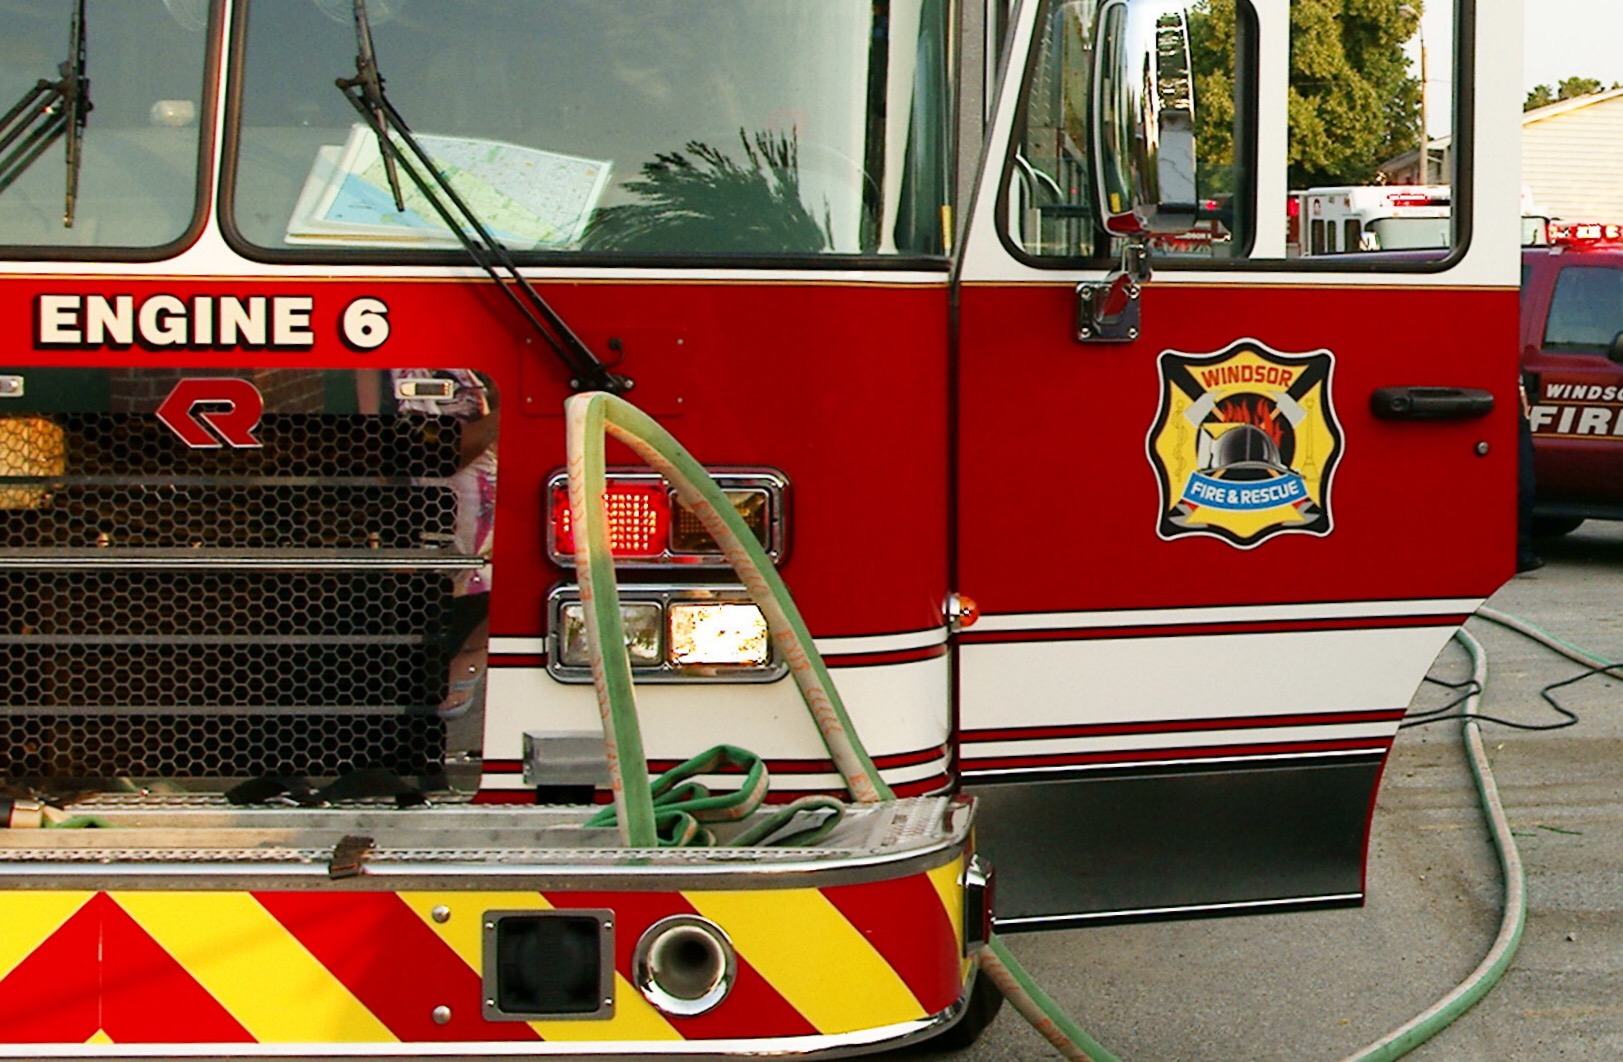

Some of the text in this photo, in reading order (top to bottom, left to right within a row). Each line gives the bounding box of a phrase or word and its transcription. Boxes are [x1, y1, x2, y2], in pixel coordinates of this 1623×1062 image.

[36, 294, 389, 349] ENGINE 6
[1201, 365, 1293, 388] WINDSOR
[1191, 481, 1299, 504] FIRE & RESCUE
